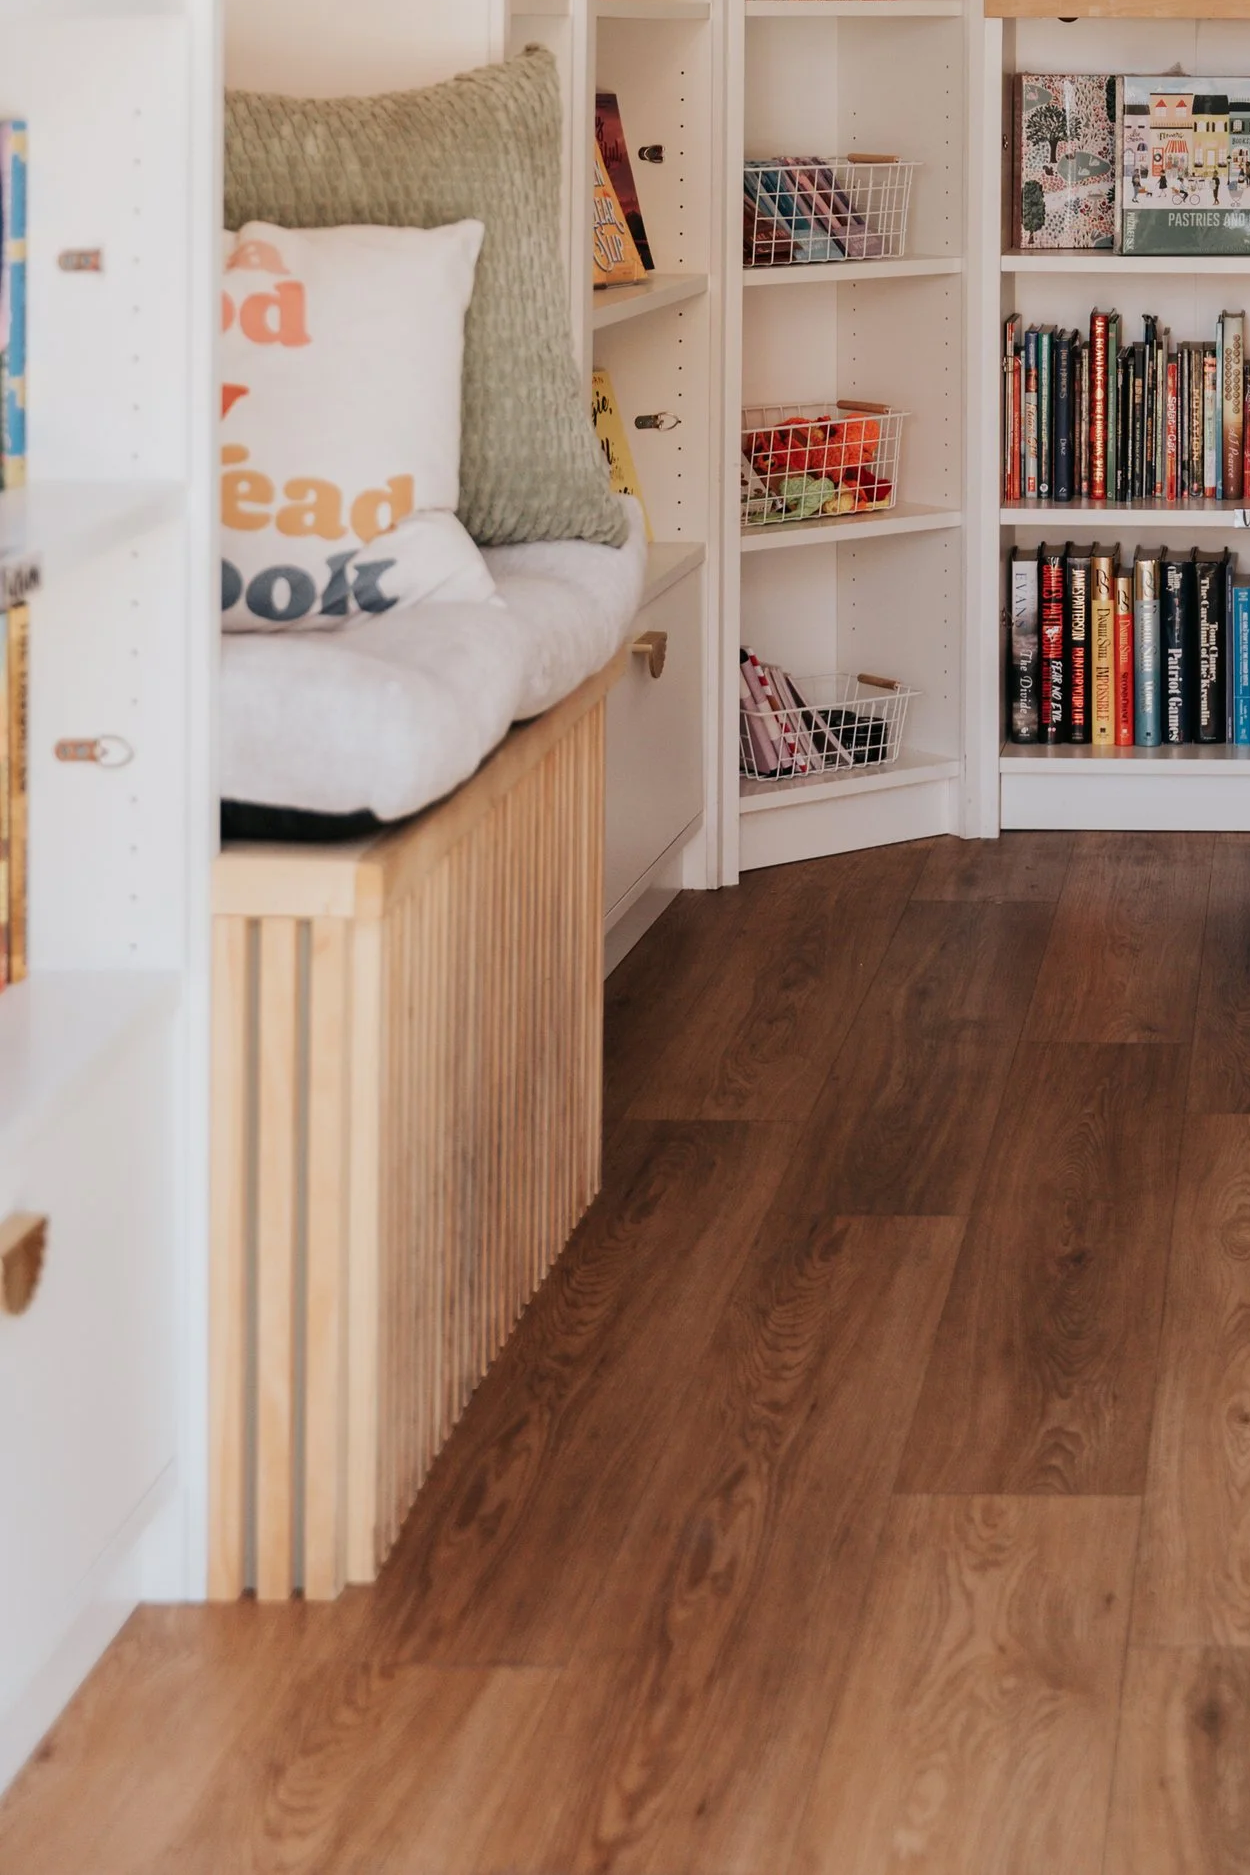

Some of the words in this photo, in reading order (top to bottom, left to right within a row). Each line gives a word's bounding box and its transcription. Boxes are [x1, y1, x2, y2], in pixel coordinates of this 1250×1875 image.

[1169, 213, 1220, 226] PASTRIES
[1223, 213, 1245, 226] AND
[1095, 338, 1106, 385] ROWLING
[1167, 396, 1177, 425] Splat
[1192, 389, 1200, 460] MUTATION
[1167, 434, 1177, 454] Cat
[1226, 446, 1238, 478] Pearce
[221, 475, 414, 547] ead
[1042, 564, 1063, 599] JAMES
[1072, 568, 1086, 595] JAMES
[1200, 577, 1210, 598] The
[1015, 572, 1028, 628] EVANS
[1042, 602, 1063, 659] PATTERSON
[1072, 595, 1086, 640] PATTERSON
[1200, 600, 1210, 645] Cardinal
[1209, 622, 1219, 643] Tom
[1019, 649, 1032, 671] The
[1072, 647, 1085, 667] RUN
[1200, 646, 1210, 657] of
[1207, 646, 1219, 682] Clancy
[1051, 660, 1063, 683] FEAR
[1072, 669, 1085, 685] FOR
[1168, 648, 1183, 694] Patriot
[1200, 658, 1210, 677] the
[1019, 675, 1033, 714] Divide
[1051, 685, 1063, 700] NO
[1072, 685, 1085, 707] YOUR
[1096, 666, 1110, 721] IMPOSSIBLE
[1200, 679, 1210, 725] Kremlin
[1051, 702, 1063, 724] EVIL
[1072, 709, 1085, 725] LIFE
[1168, 697, 1183, 741] Games
